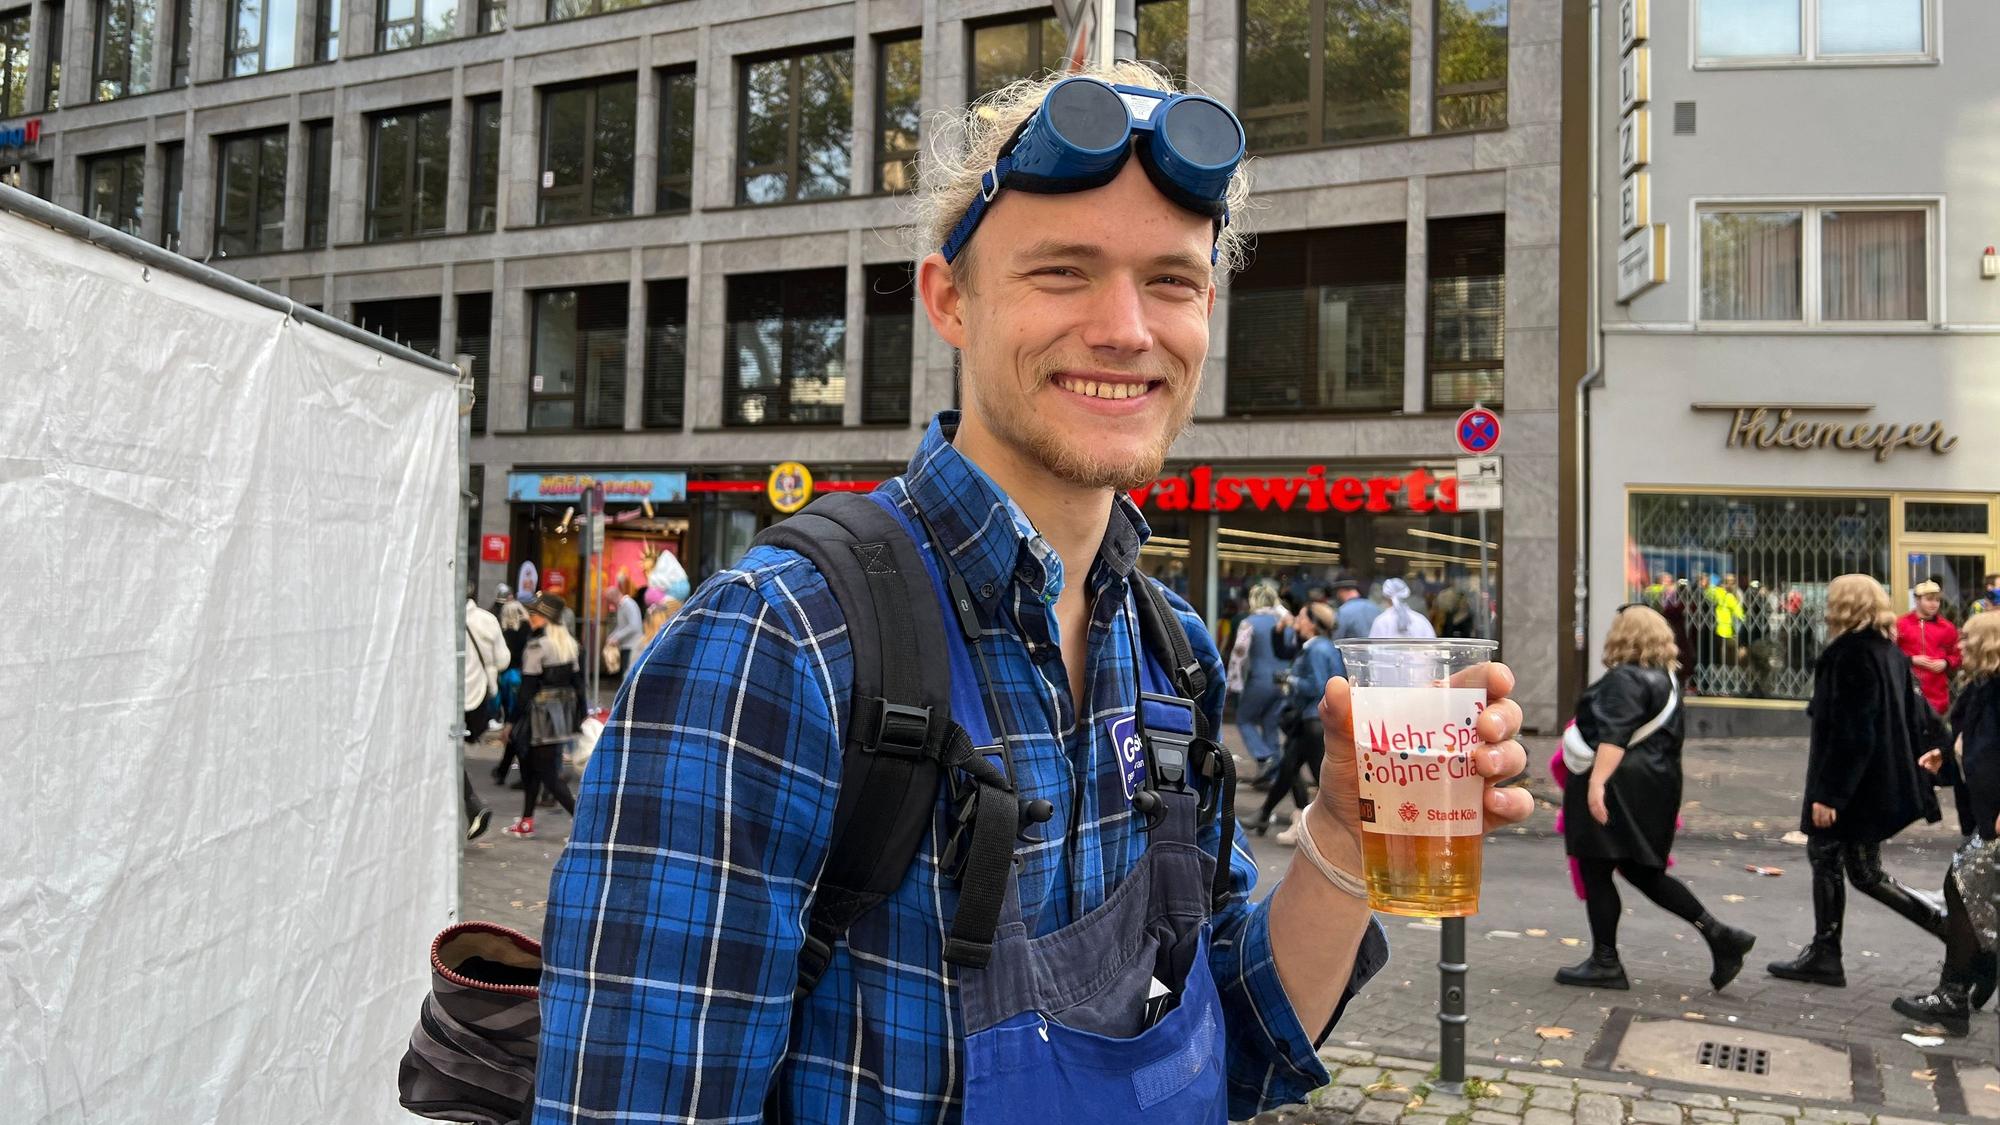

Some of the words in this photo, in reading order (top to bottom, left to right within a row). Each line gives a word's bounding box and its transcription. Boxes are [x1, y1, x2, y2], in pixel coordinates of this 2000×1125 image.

[1691, 402, 1960, 463] Thiemeyer
[1368, 720, 1436, 752] Mehr
[1443, 723, 1479, 752] Spa
[1376, 757, 1440, 784] ohne
[1448, 753, 1477, 779] Gla
[1427, 809, 1459, 821] Stadt
[1461, 809, 1477, 820] Köln
